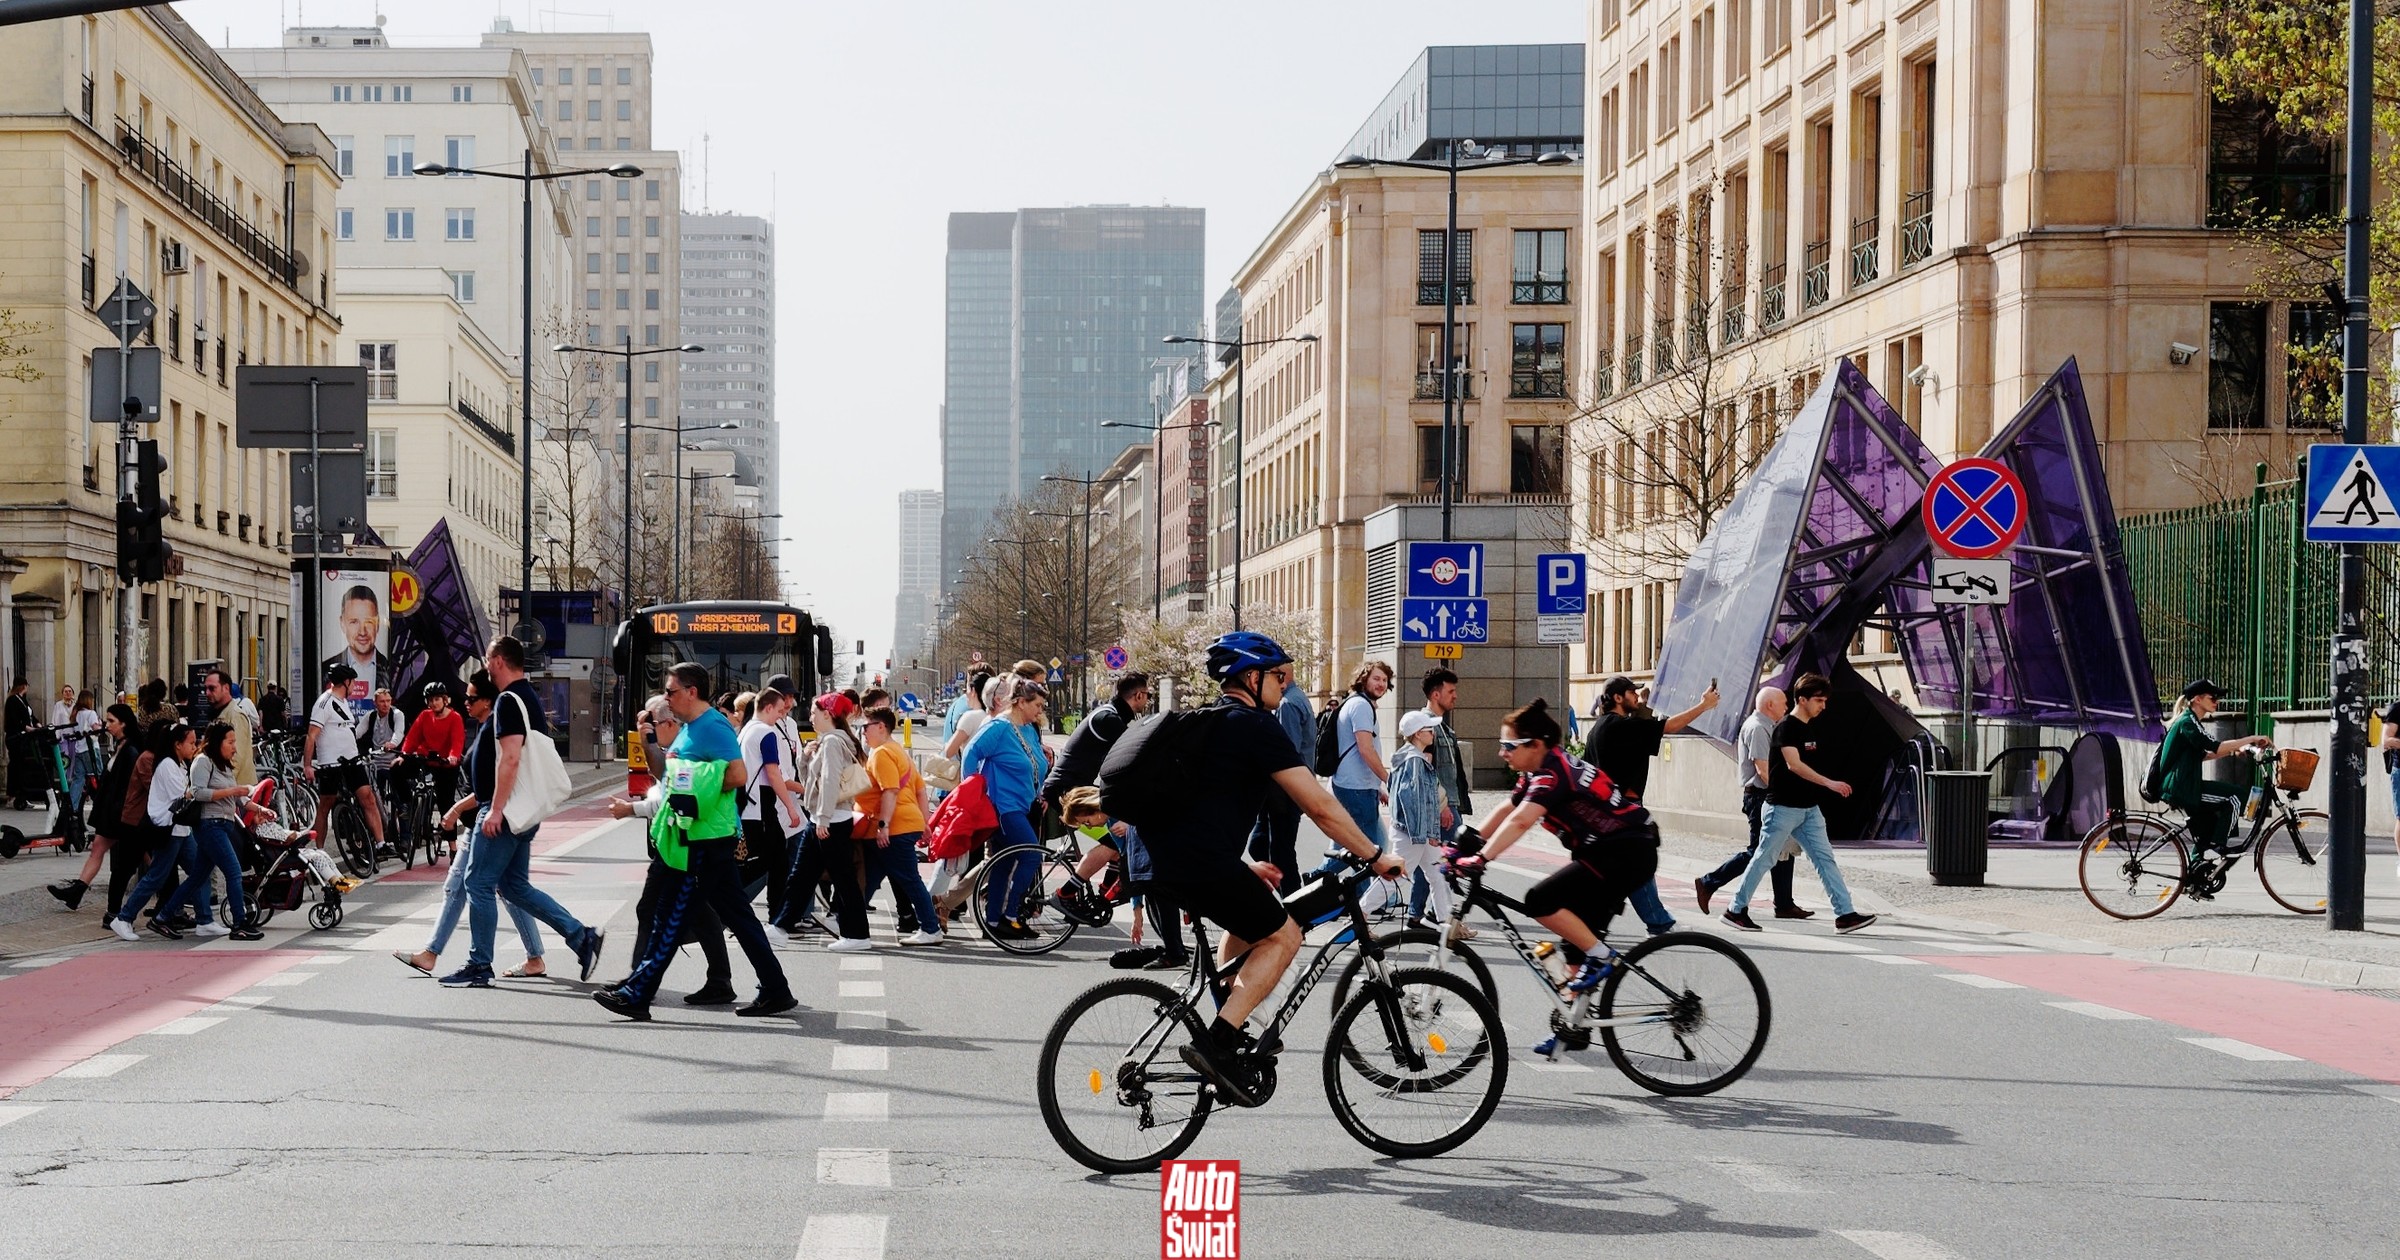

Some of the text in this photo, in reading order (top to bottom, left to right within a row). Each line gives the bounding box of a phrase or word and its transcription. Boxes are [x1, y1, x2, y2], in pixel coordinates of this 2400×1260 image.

[1549, 559, 1576, 596] P
[652, 613, 679, 634] 106
[695, 614, 761, 623] MARIENSZTAT
[688, 623, 770, 632] TRASA ZMIENIONA
[1435, 645, 1454, 657] 719
